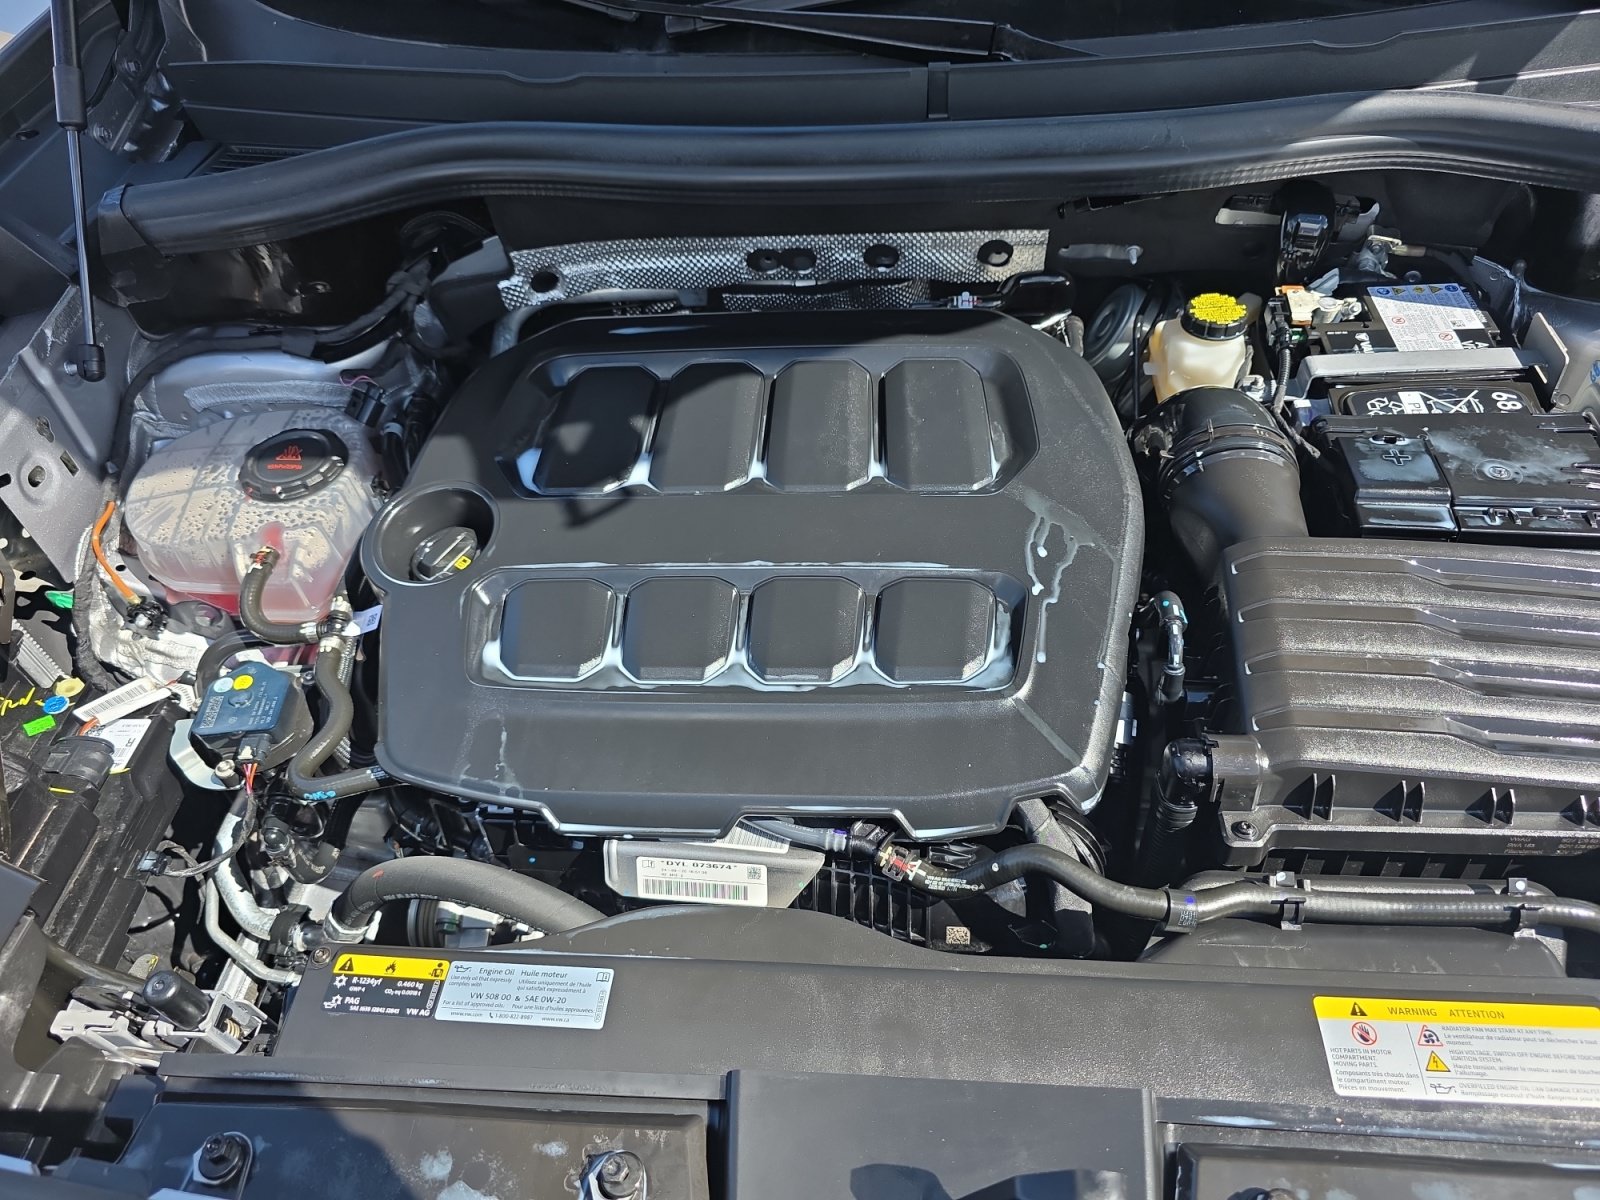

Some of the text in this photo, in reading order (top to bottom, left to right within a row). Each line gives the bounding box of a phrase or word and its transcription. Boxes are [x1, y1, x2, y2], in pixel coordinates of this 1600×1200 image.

[479, 967, 503, 976] Engine
[352, 977, 382, 987] R-1234yf
[416, 982, 424, 990] kg
[344, 996, 360, 1005] PAG
[1387, 1007, 1505, 1019] WARNING ATTENTION
